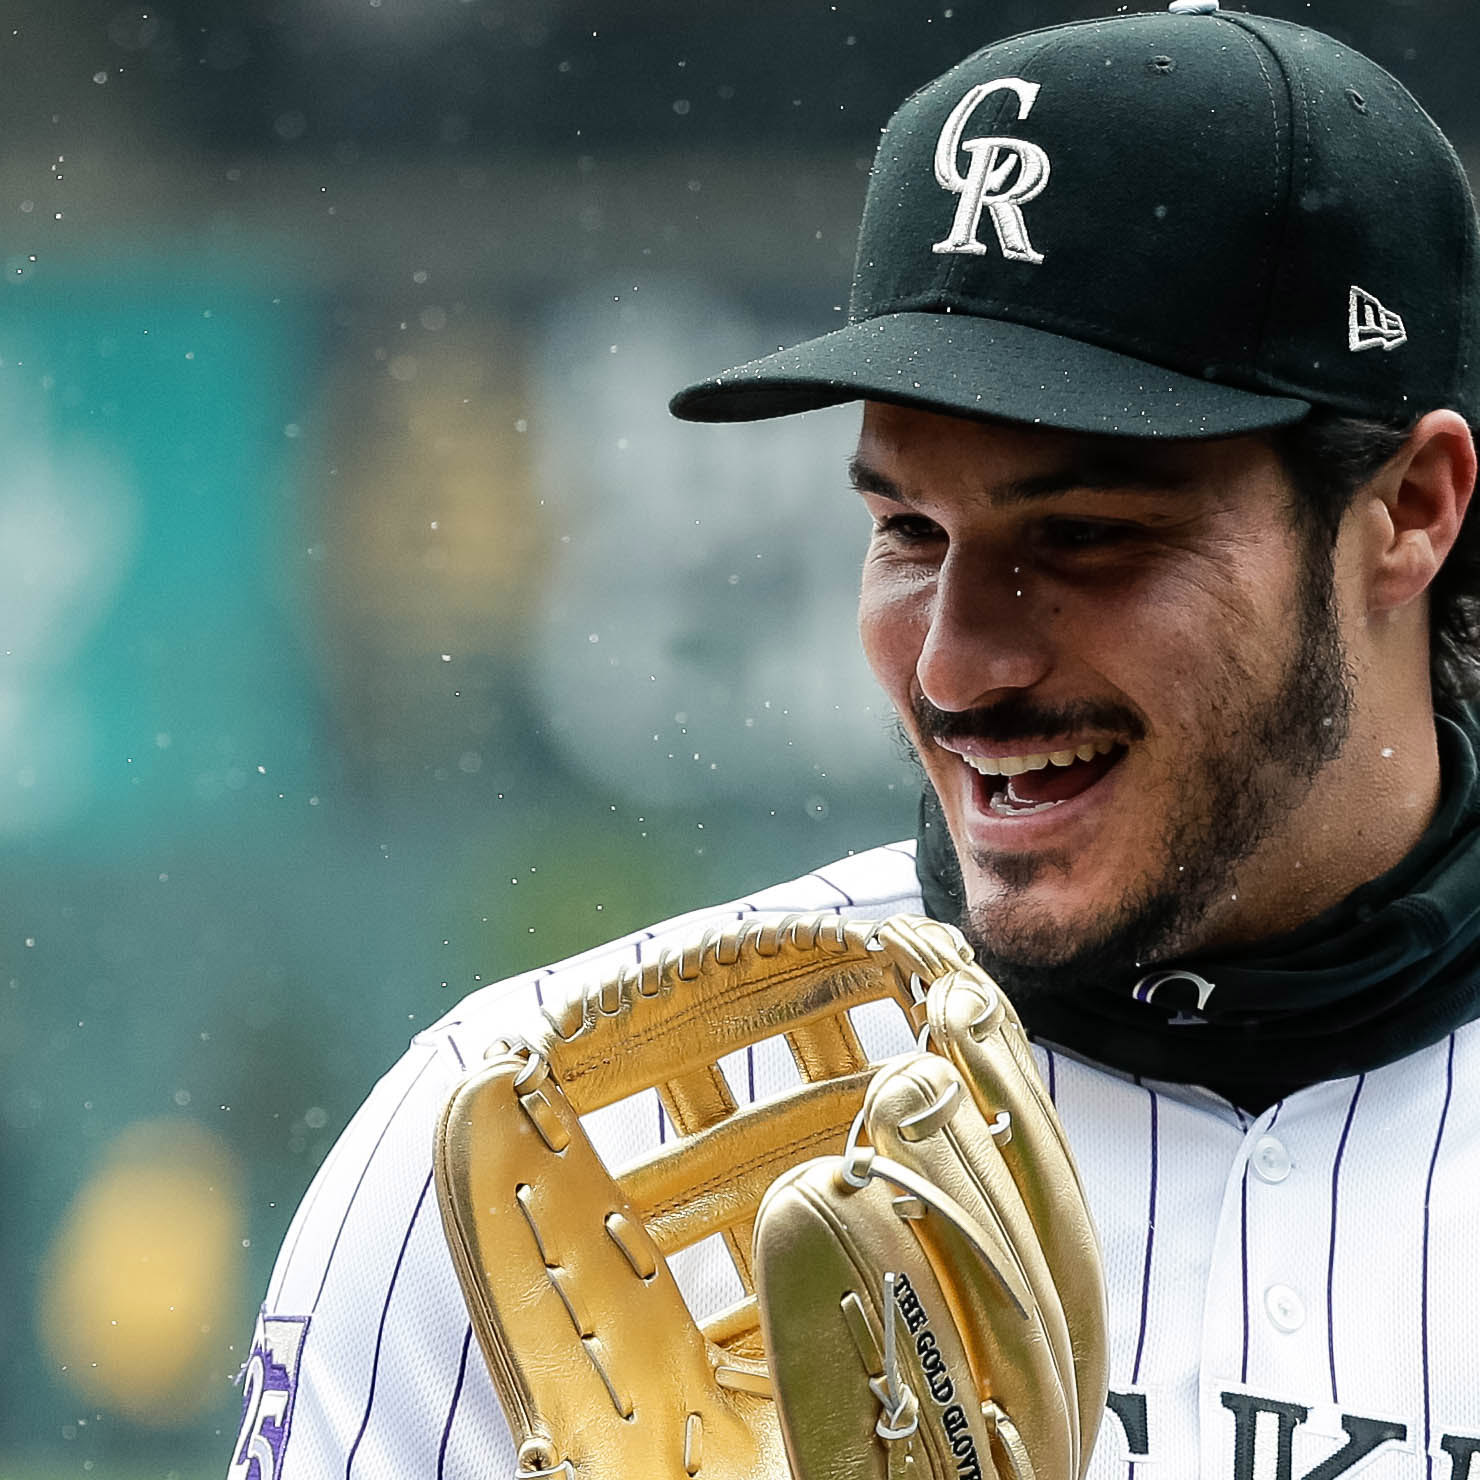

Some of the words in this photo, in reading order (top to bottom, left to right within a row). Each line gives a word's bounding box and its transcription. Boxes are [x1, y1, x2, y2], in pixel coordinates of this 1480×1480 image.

[932, 77, 1052, 264] CR
[894, 1272, 928, 1335] THE
[916, 1330, 955, 1404] GOLD
